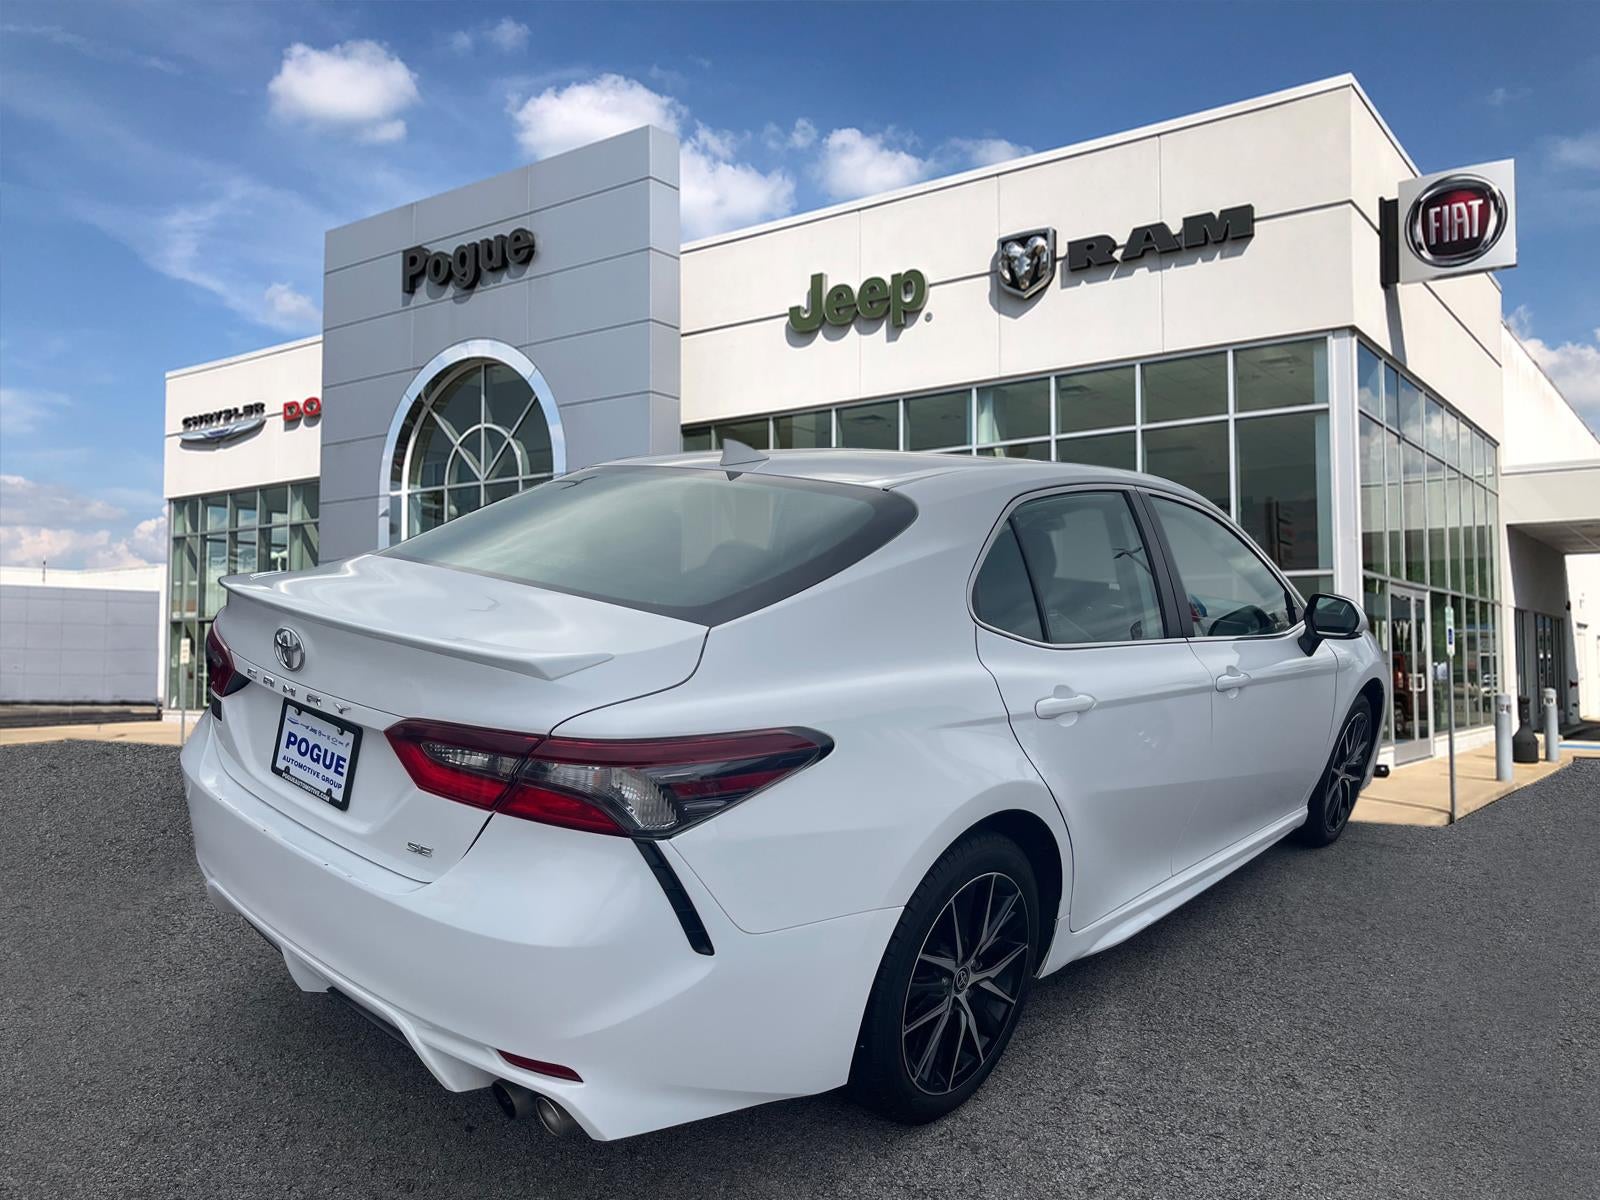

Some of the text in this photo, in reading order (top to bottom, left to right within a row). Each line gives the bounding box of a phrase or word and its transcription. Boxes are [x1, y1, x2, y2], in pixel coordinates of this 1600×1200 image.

[1067, 204, 1254, 271] RAM
[1428, 199, 1484, 246] FIAT
[402, 227, 534, 294] Pogue
[788, 268, 928, 332] Jeep
[247, 668, 352, 714] CAMRY
[282, 755, 342, 789] AUTOMOTIVE GROUP
[285, 731, 347, 777] POGUE
[407, 841, 432, 857] SE
